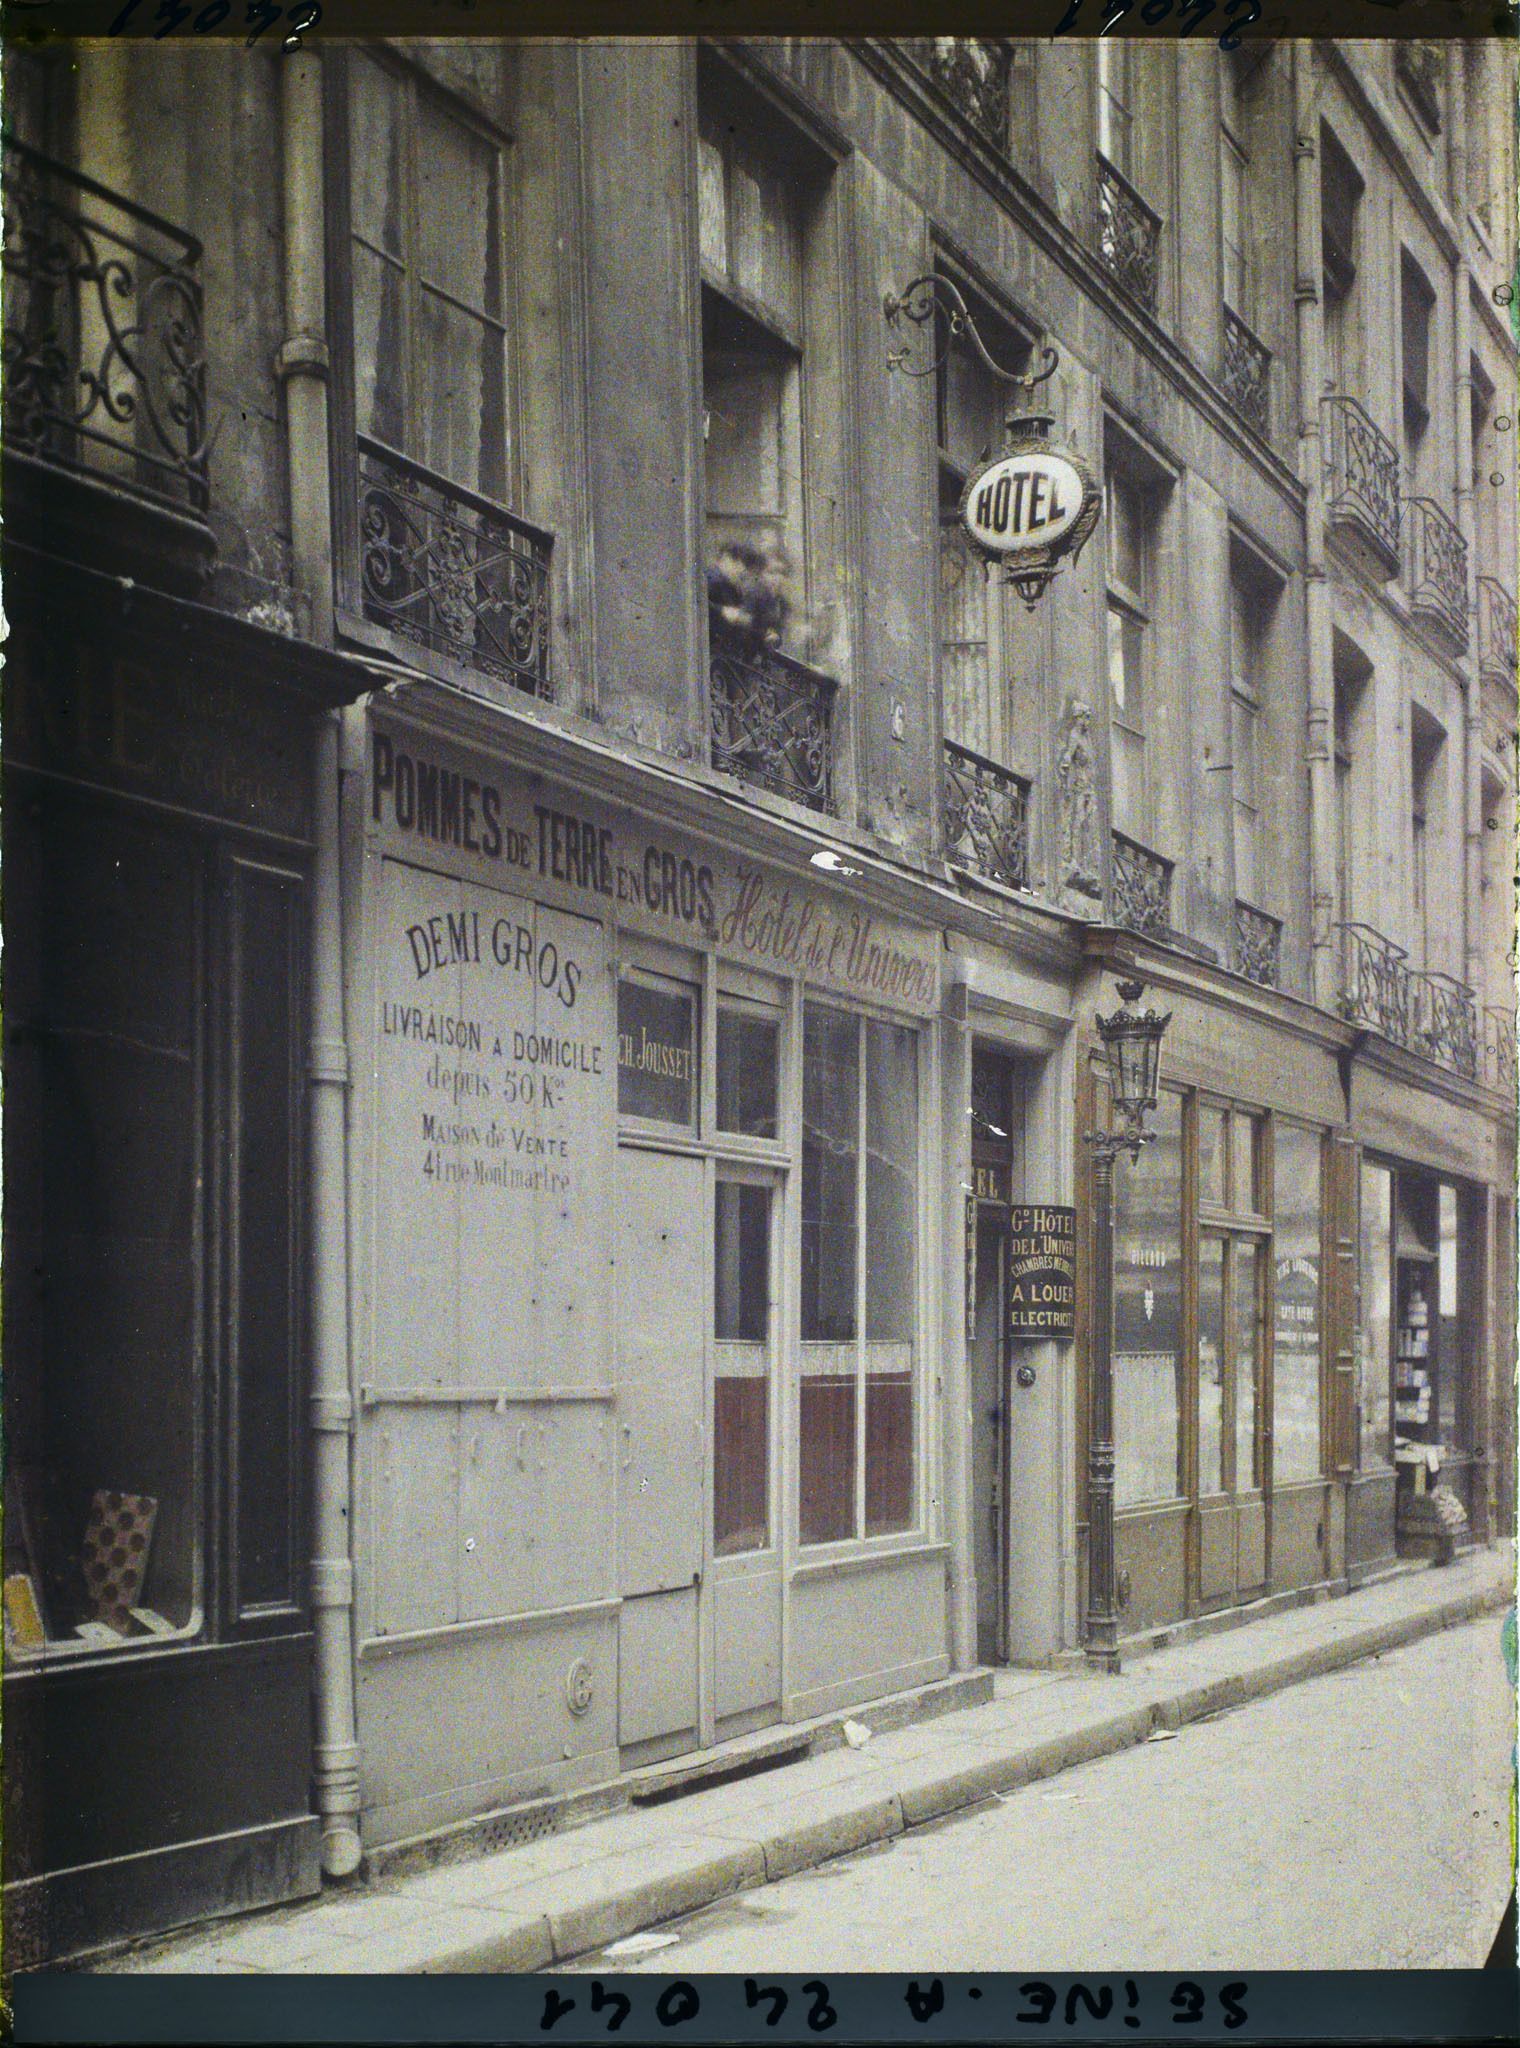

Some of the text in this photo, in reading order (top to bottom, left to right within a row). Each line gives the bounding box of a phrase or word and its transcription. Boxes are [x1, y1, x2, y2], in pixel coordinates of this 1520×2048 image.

[975, 468, 1066, 534] HÔTEL
[372, 731, 501, 857] POMMES
[506, 826, 531, 869] DE
[533, 804, 614, 897] TERRE
[616, 865, 642, 906] EN
[721, 864, 813, 965] Hôtel
[804, 922, 826, 969] de
[405, 911, 582, 1008] DEMI GROS
[383, 1001, 601, 1075] LIVRAISON A DOMICILE
[636, 1026, 691, 1081] JOUSSET
[426, 1052, 491, 1106] depuis
[503, 1069, 534, 1105] 50
[512, 1126, 568, 1158] VENTE
[1011, 1256, 1053, 1279] CHAMBRES
[1011, 1284, 1025, 1303] A
